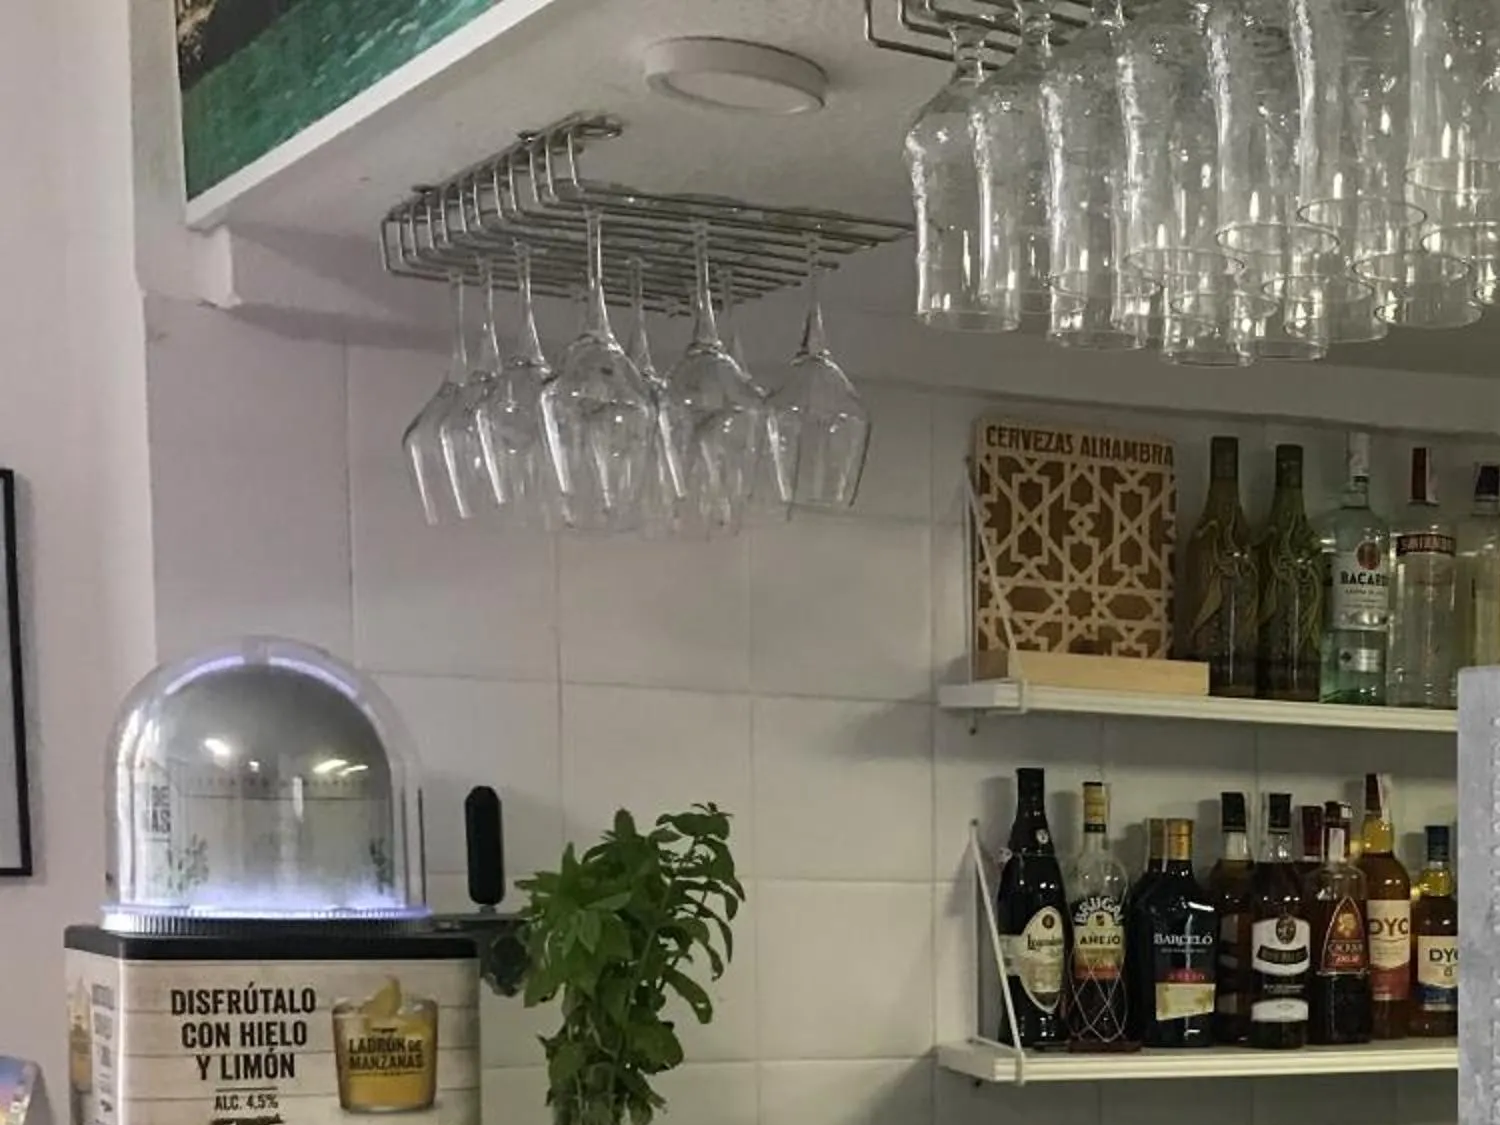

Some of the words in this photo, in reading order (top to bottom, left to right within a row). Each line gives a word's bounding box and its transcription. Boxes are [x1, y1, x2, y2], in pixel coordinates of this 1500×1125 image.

[986, 425, 1073, 455] CERVEZAS
[1079, 435, 1175, 466] ALHAMBRA
[1153, 931, 1214, 947] BARCELÓ
[171, 981, 317, 1016] DISFRÚTALO
[181, 1022, 231, 1049] CON
[239, 1020, 308, 1048] HIELO
[195, 1054, 212, 1081] Y
[220, 1048, 296, 1081] LIMÓN
[349, 1053, 424, 1071] MANZANAS
